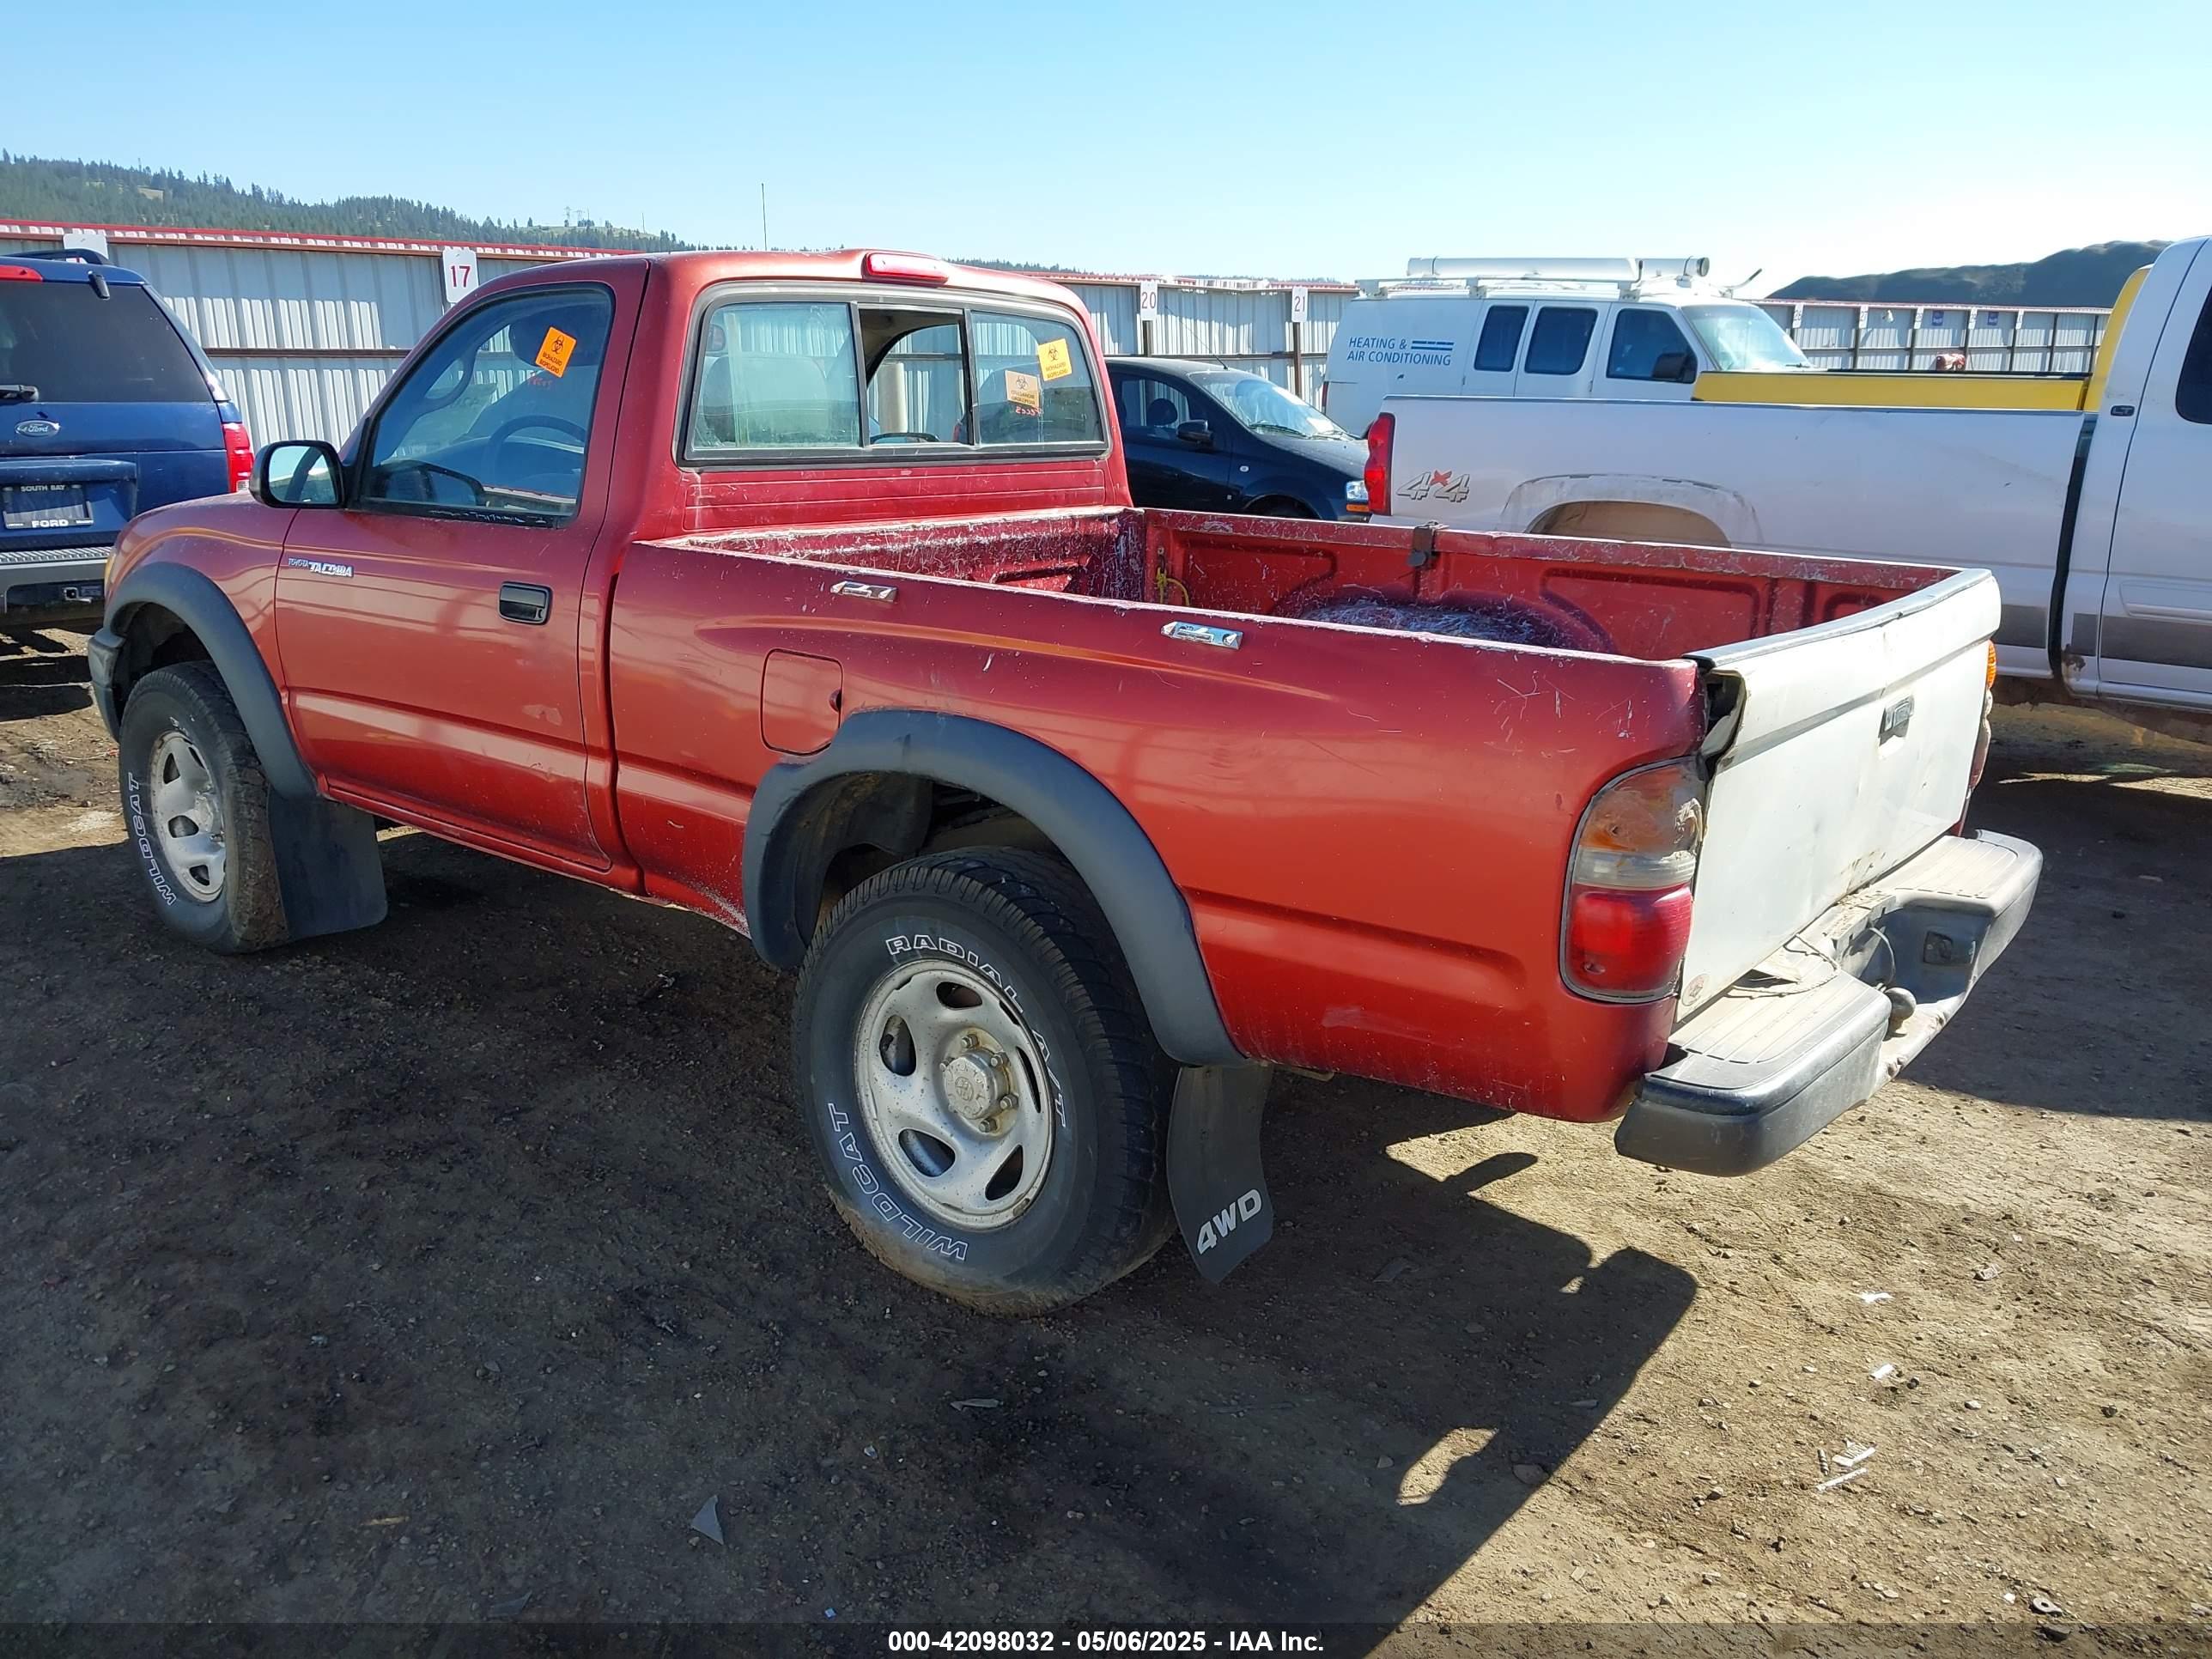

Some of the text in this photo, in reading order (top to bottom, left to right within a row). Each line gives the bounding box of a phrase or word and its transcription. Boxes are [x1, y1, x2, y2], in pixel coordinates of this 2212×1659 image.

[450, 264, 471, 288] 17
[1141, 291, 1157, 309] 20
[1294, 295, 1305, 312] 21
[1349, 337, 1407, 349] HEATING &
[1347, 350, 1451, 366] AIR CONDITIONING
[2112, 407, 2133, 416] LT
[31, 519, 69, 528] FORD
[129, 772, 177, 906] WILDCAT
[885, 934, 1024, 1014] RADIAL
[828, 1103, 969, 1261] WILDCAT
[1197, 1188, 1262, 1255] 4WD
